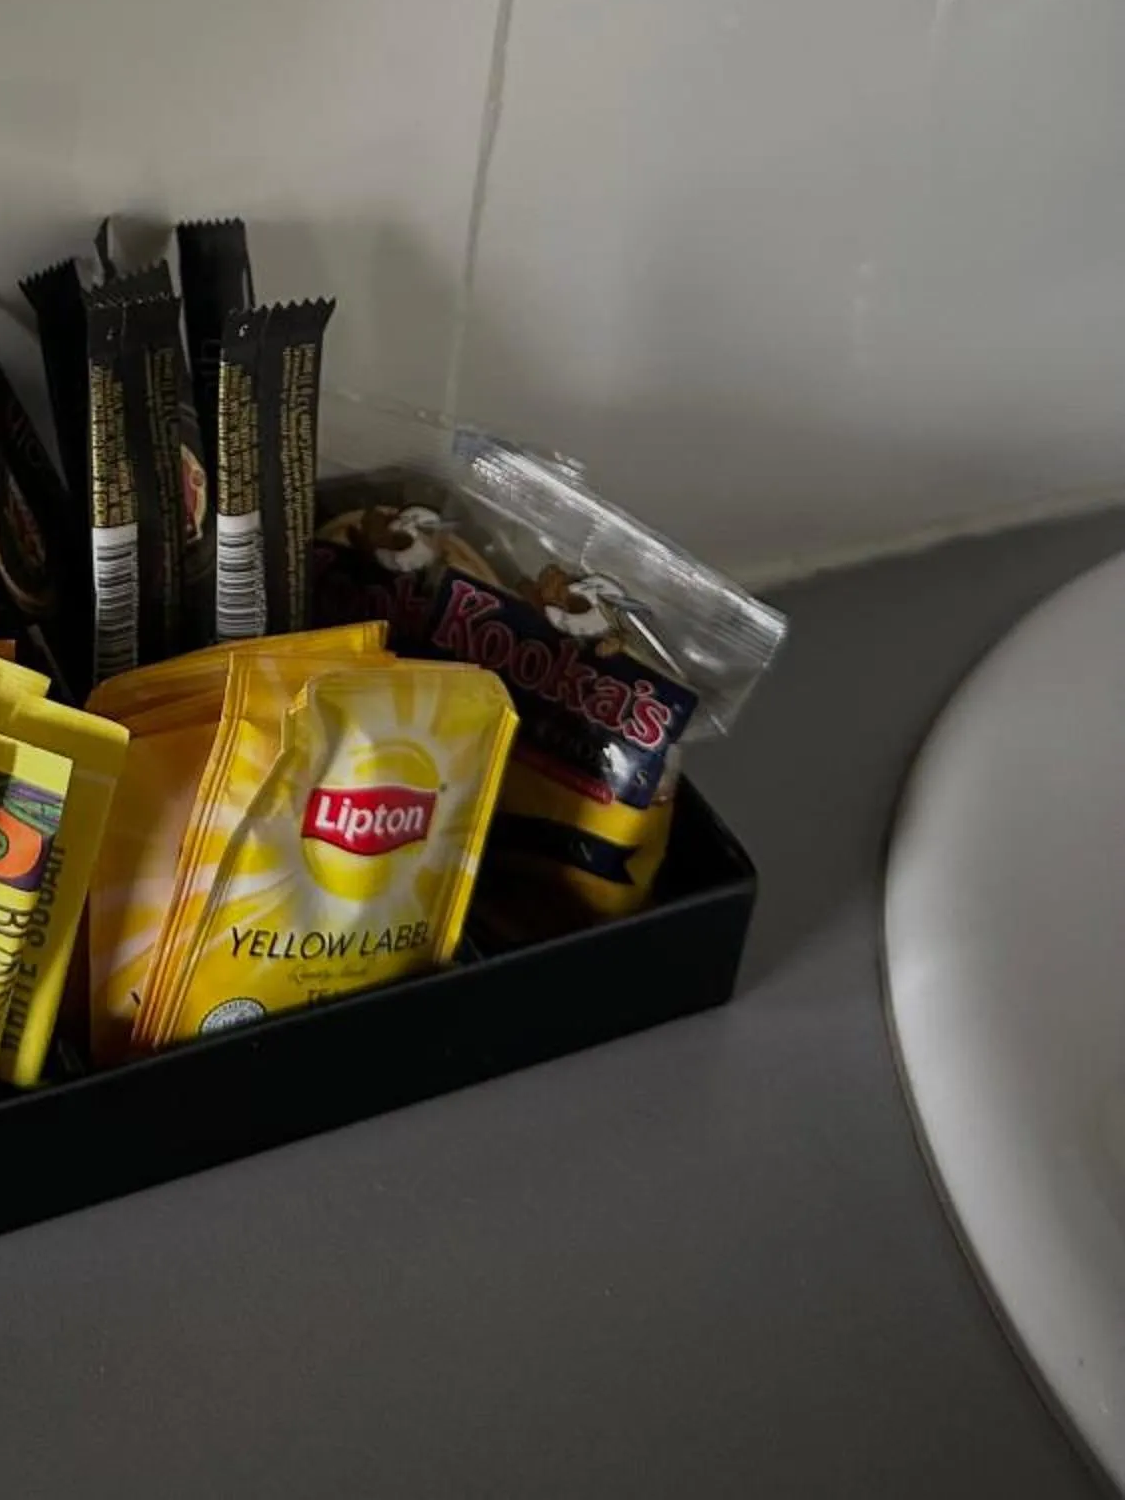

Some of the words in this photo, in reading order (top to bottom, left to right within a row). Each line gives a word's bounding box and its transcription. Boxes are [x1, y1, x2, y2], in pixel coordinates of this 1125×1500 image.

[432, 578, 673, 749] Kooka's
[314, 795, 424, 842] Lipton
[231, 925, 357, 960] YELLOW
